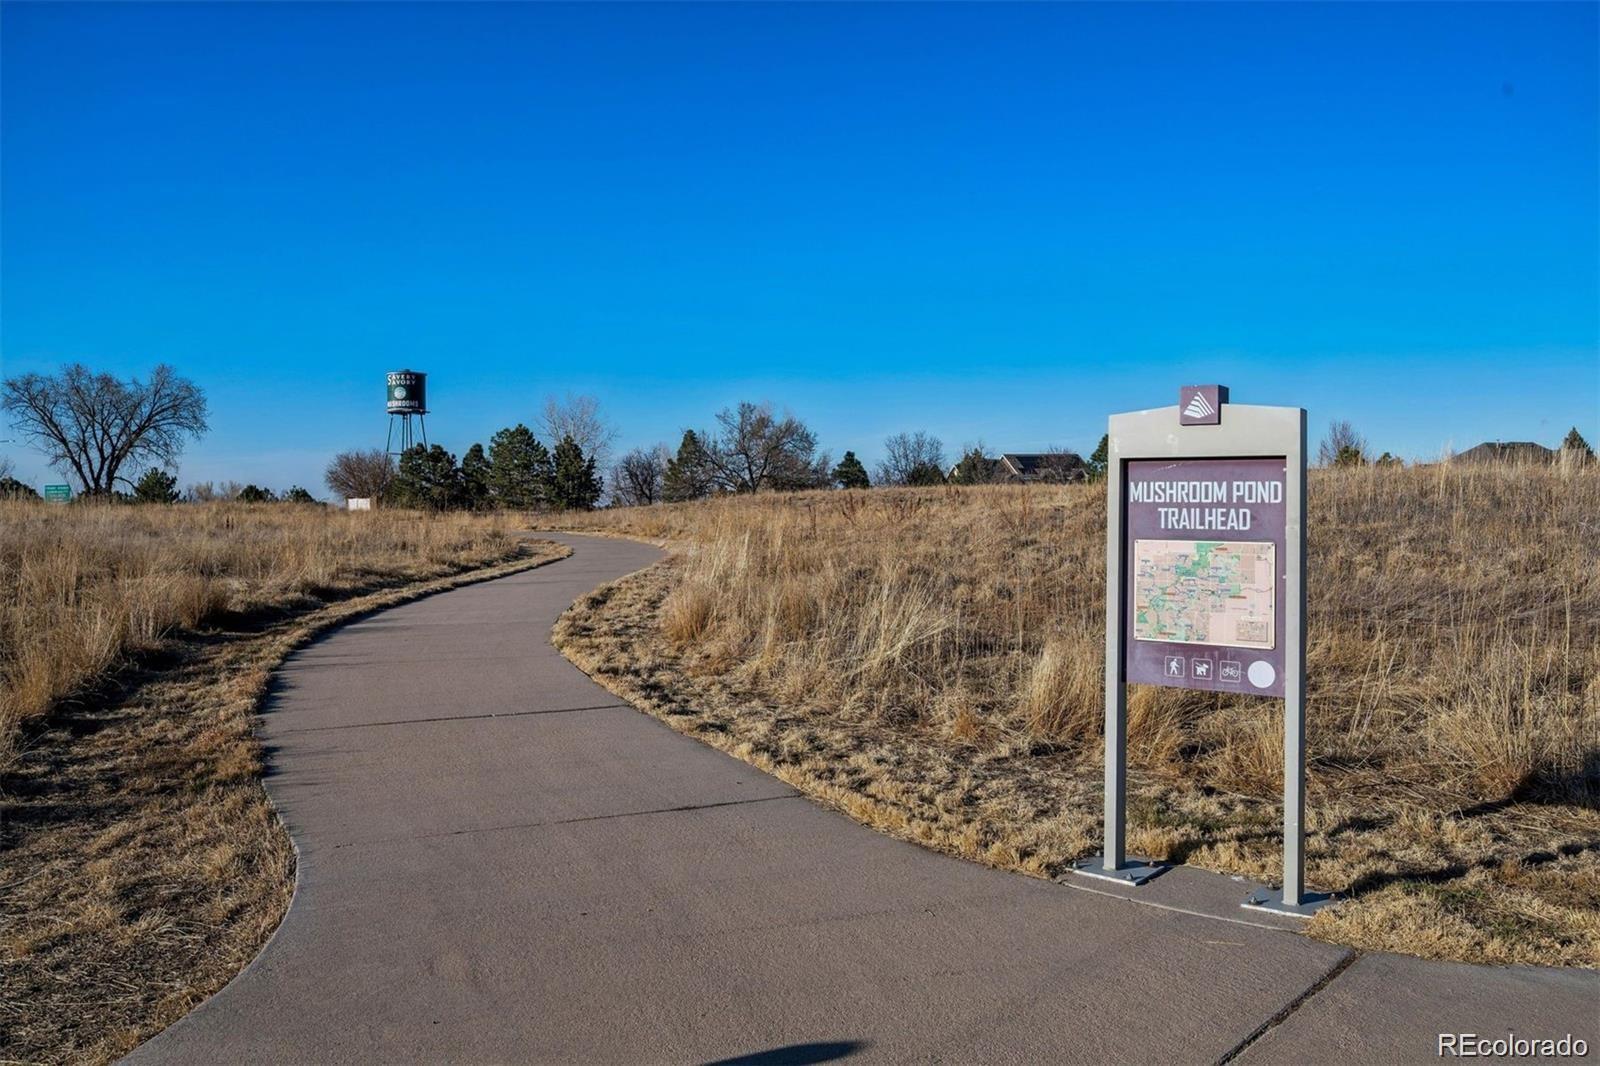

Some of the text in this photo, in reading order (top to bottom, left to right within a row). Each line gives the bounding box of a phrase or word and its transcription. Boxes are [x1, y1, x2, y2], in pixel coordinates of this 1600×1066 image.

[1129, 481, 1283, 504] MUSHROOM POND
[1157, 507, 1251, 530] TRAILHEAD
